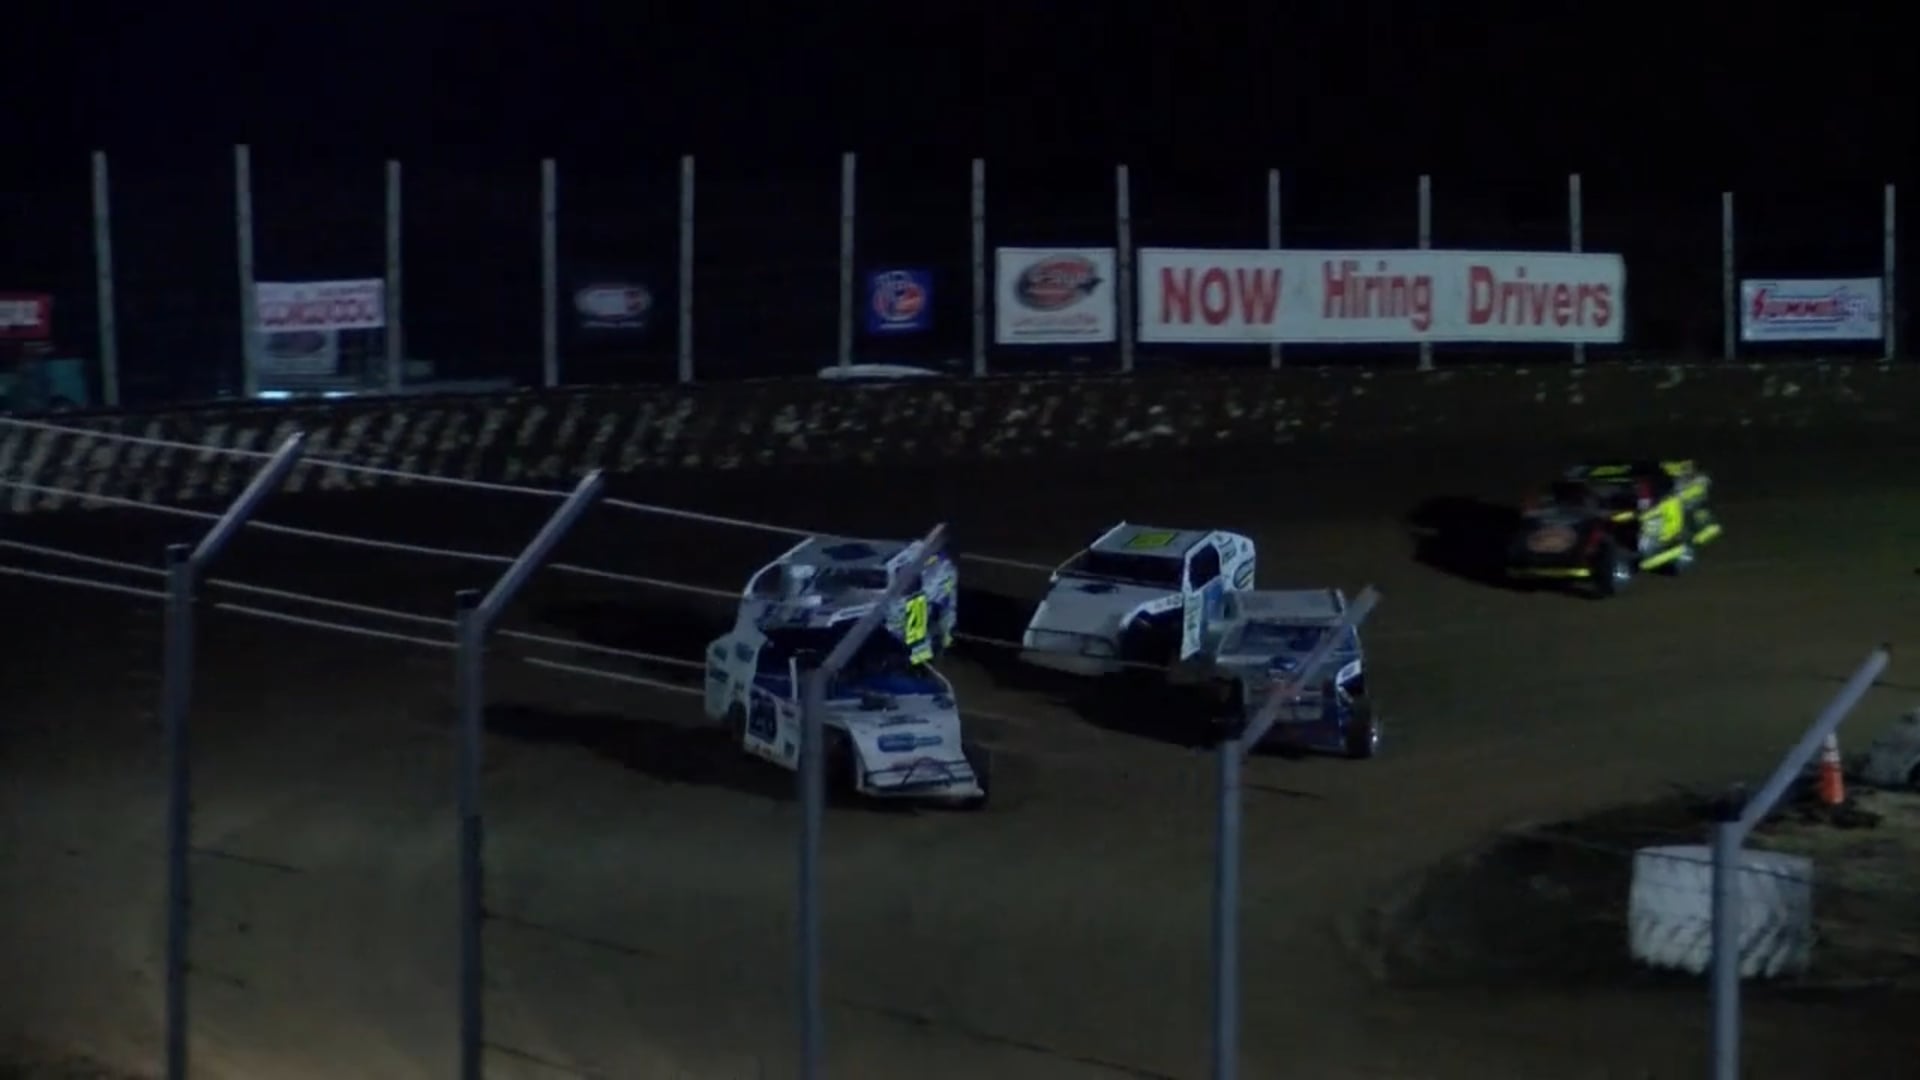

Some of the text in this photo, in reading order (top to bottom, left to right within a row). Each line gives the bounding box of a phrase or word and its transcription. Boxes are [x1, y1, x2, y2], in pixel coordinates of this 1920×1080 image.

[1159, 266, 1282, 326] NOW
[1323, 260, 1432, 332] Hiring
[1467, 265, 1612, 328] Drivers
